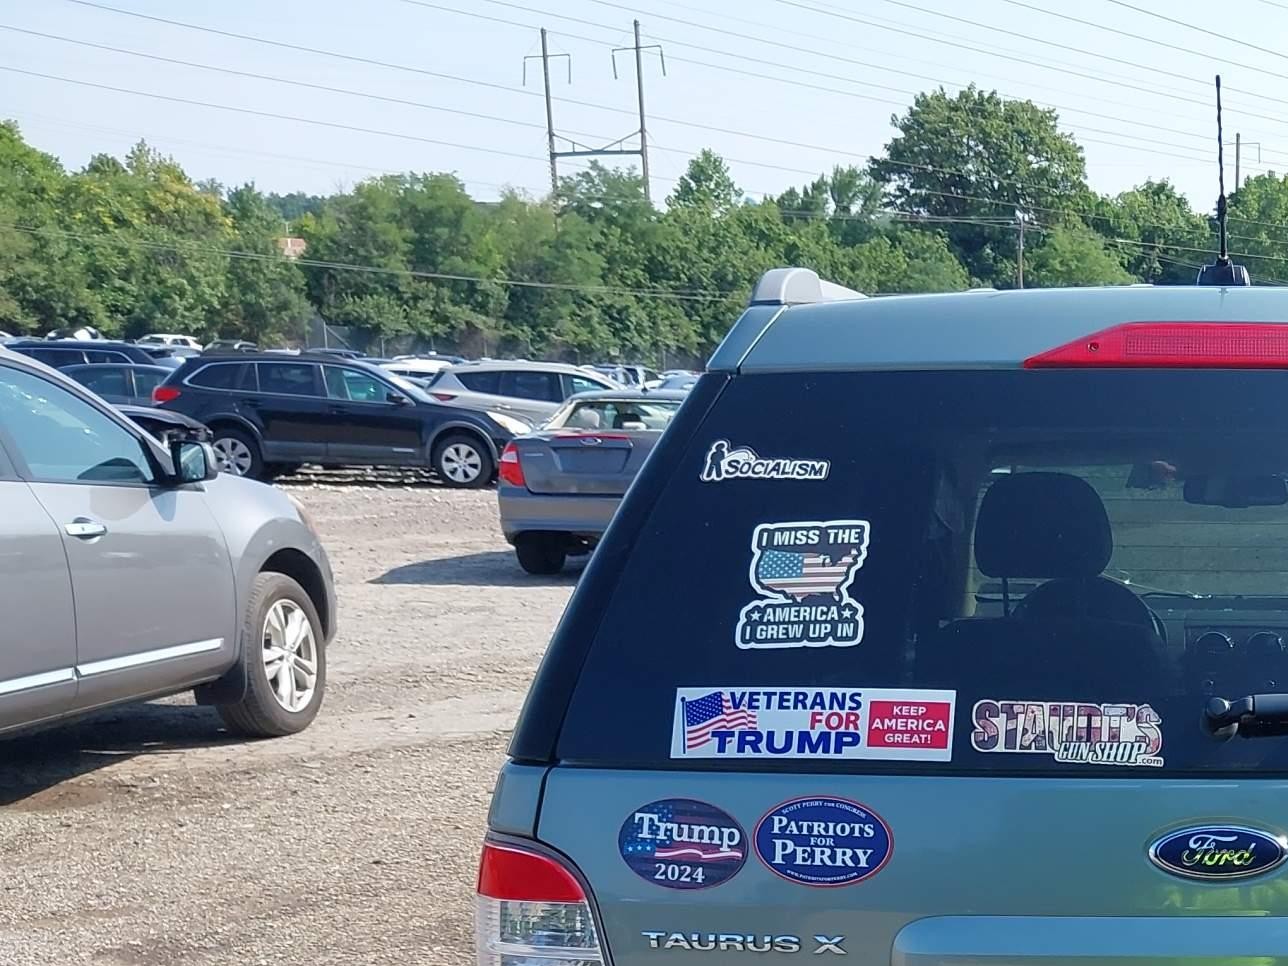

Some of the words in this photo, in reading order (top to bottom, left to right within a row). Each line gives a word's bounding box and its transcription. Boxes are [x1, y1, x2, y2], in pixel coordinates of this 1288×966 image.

[725, 460, 825, 476] SOCIALISM
[762, 532, 768, 547] I
[774, 530, 820, 546] MISS
[828, 528, 861, 544] THE
[763, 606, 839, 622] AMERICA
[745, 626, 751, 640] I
[756, 624, 804, 639] GREW
[809, 623, 832, 638] UP
[836, 622, 854, 638] IN
[729, 691, 863, 711] VETERANS
[809, 711, 861, 730] FOR
[892, 706, 927, 716] KEEP
[872, 718, 946, 731] AMERICA
[711, 730, 862, 754] TRUMP
[884, 734, 932, 744] GREAT!
[781, 803, 802, 815] SCOTT
[802, 800, 824, 808] PERRY
[634, 812, 741, 851] Trump
[771, 815, 875, 838] PATRIOTS
[810, 836, 835, 846] FOR
[1181, 833, 1257, 867] Ford
[772, 839, 874, 868] PERRY
[654, 863, 706, 884] 2024
[640, 930, 801, 954] TAURUS
[812, 934, 848, 955] X
